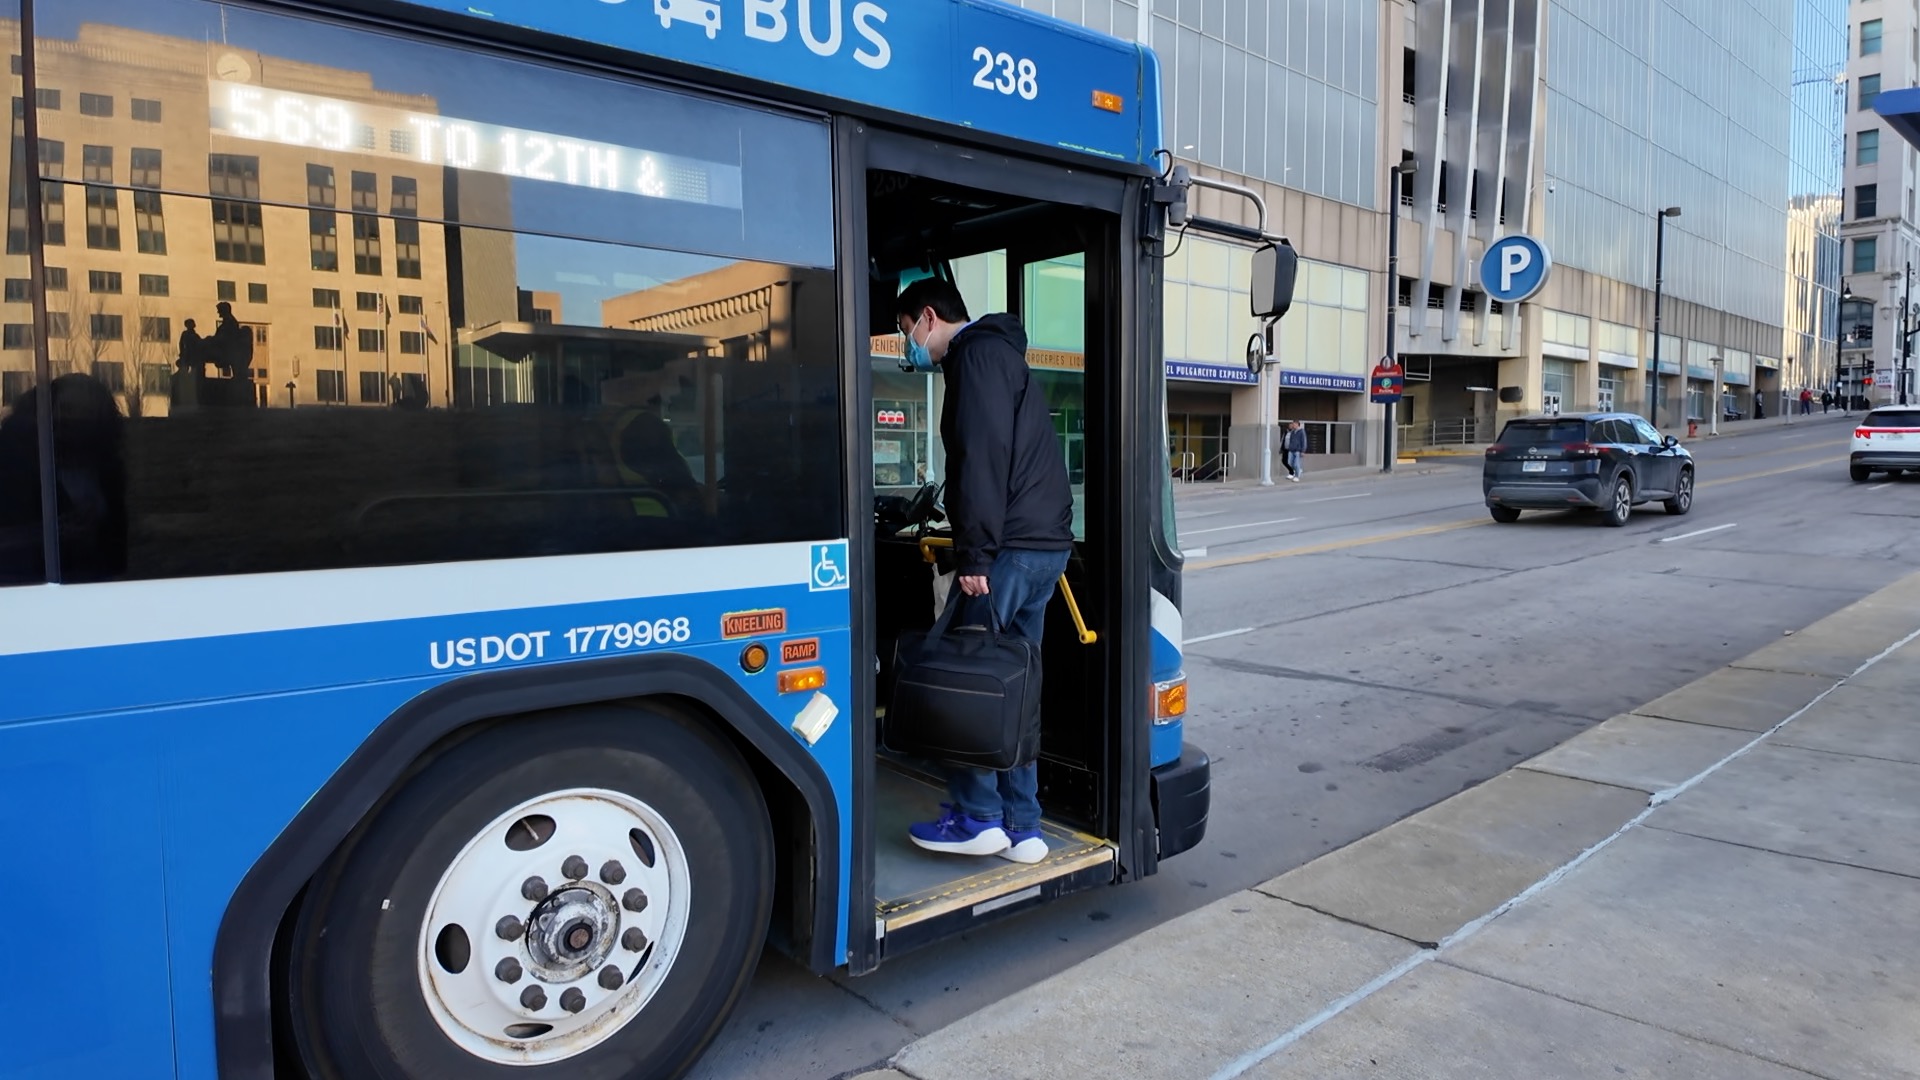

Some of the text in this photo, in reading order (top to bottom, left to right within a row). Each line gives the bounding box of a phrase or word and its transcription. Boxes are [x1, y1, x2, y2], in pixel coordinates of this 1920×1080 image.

[744, 0, 892, 70] BUS
[972, 45, 1038, 101] 238
[231, 87, 665, 197] 569 TO 12TH &
[1501, 245, 1531, 292] P
[1166, 365, 1247, 380] EL PULGARCITO EXPRESS
[1290, 375, 1356, 388] EL PULGARCITO EXPRESS
[563, 617, 691, 653] 1779968
[726, 613, 781, 634] KNEELING
[784, 643, 816, 659] RAMP
